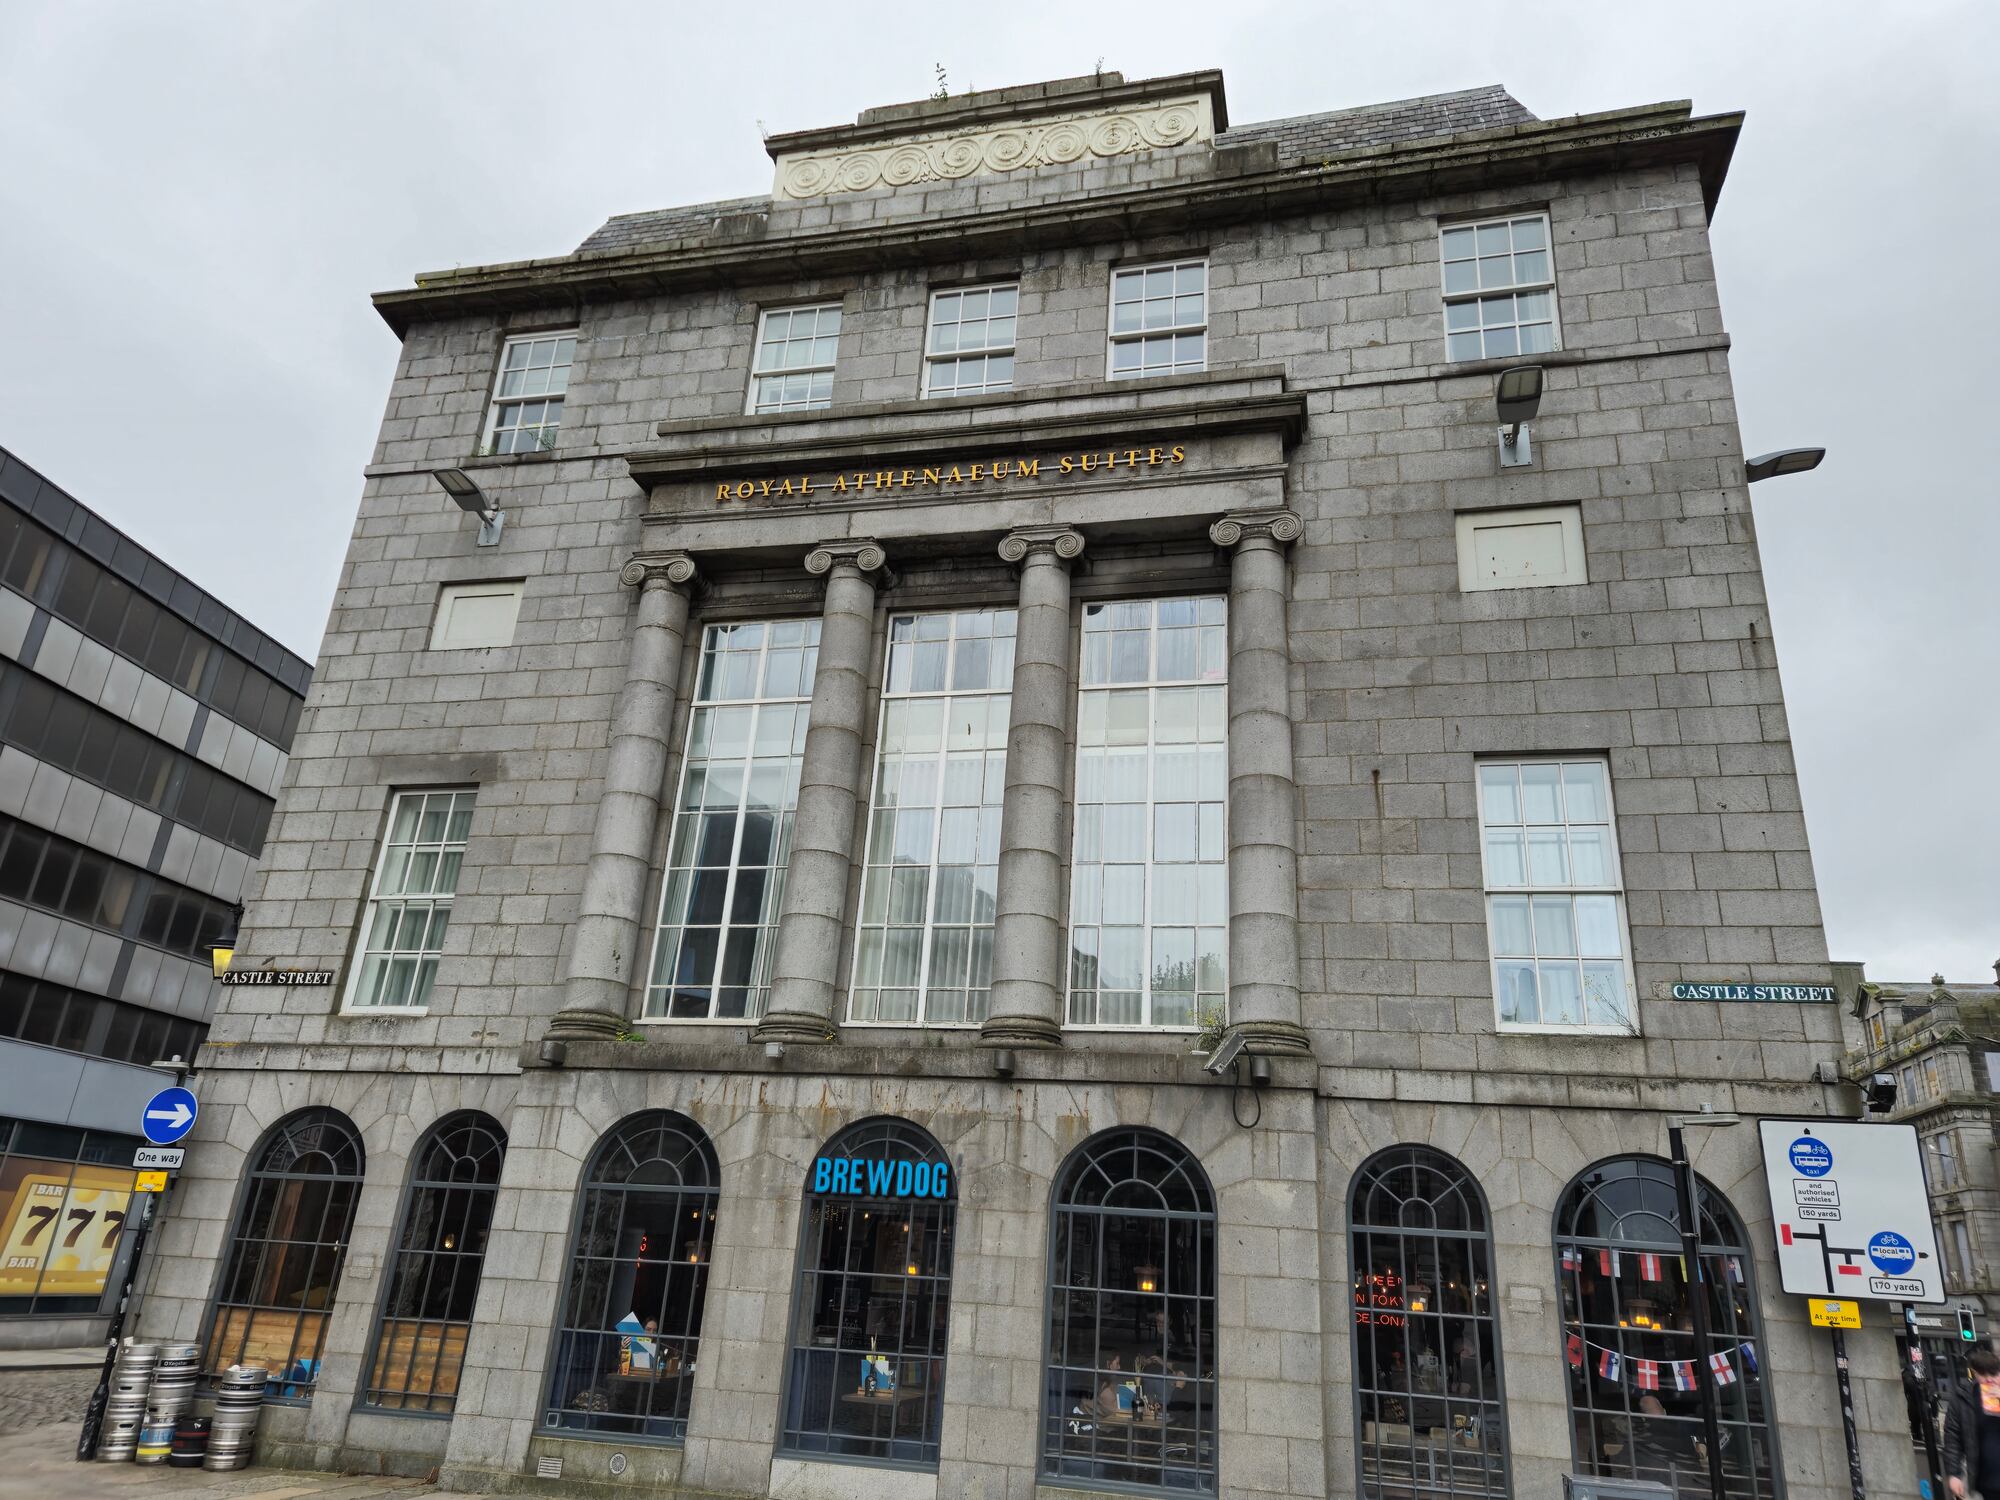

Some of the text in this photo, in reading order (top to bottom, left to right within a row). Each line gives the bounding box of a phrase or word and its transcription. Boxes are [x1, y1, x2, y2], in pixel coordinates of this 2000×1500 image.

[715, 446, 1186, 500] ROYAL ATHENAEUM SUITES
[222, 972, 332, 984] CASTLE STREET
[1673, 985, 1835, 1001] CASTLE STREET
[138, 1152, 180, 1165] One way
[814, 1157, 948, 1198] BREWDOG
[37, 1184, 64, 1196] BAR
[1879, 1247, 1898, 1255] local
[7, 1257, 36, 1268] BAR
[1874, 1281, 1920, 1292] 170 yards
[1841, 1315, 1857, 1323] time
